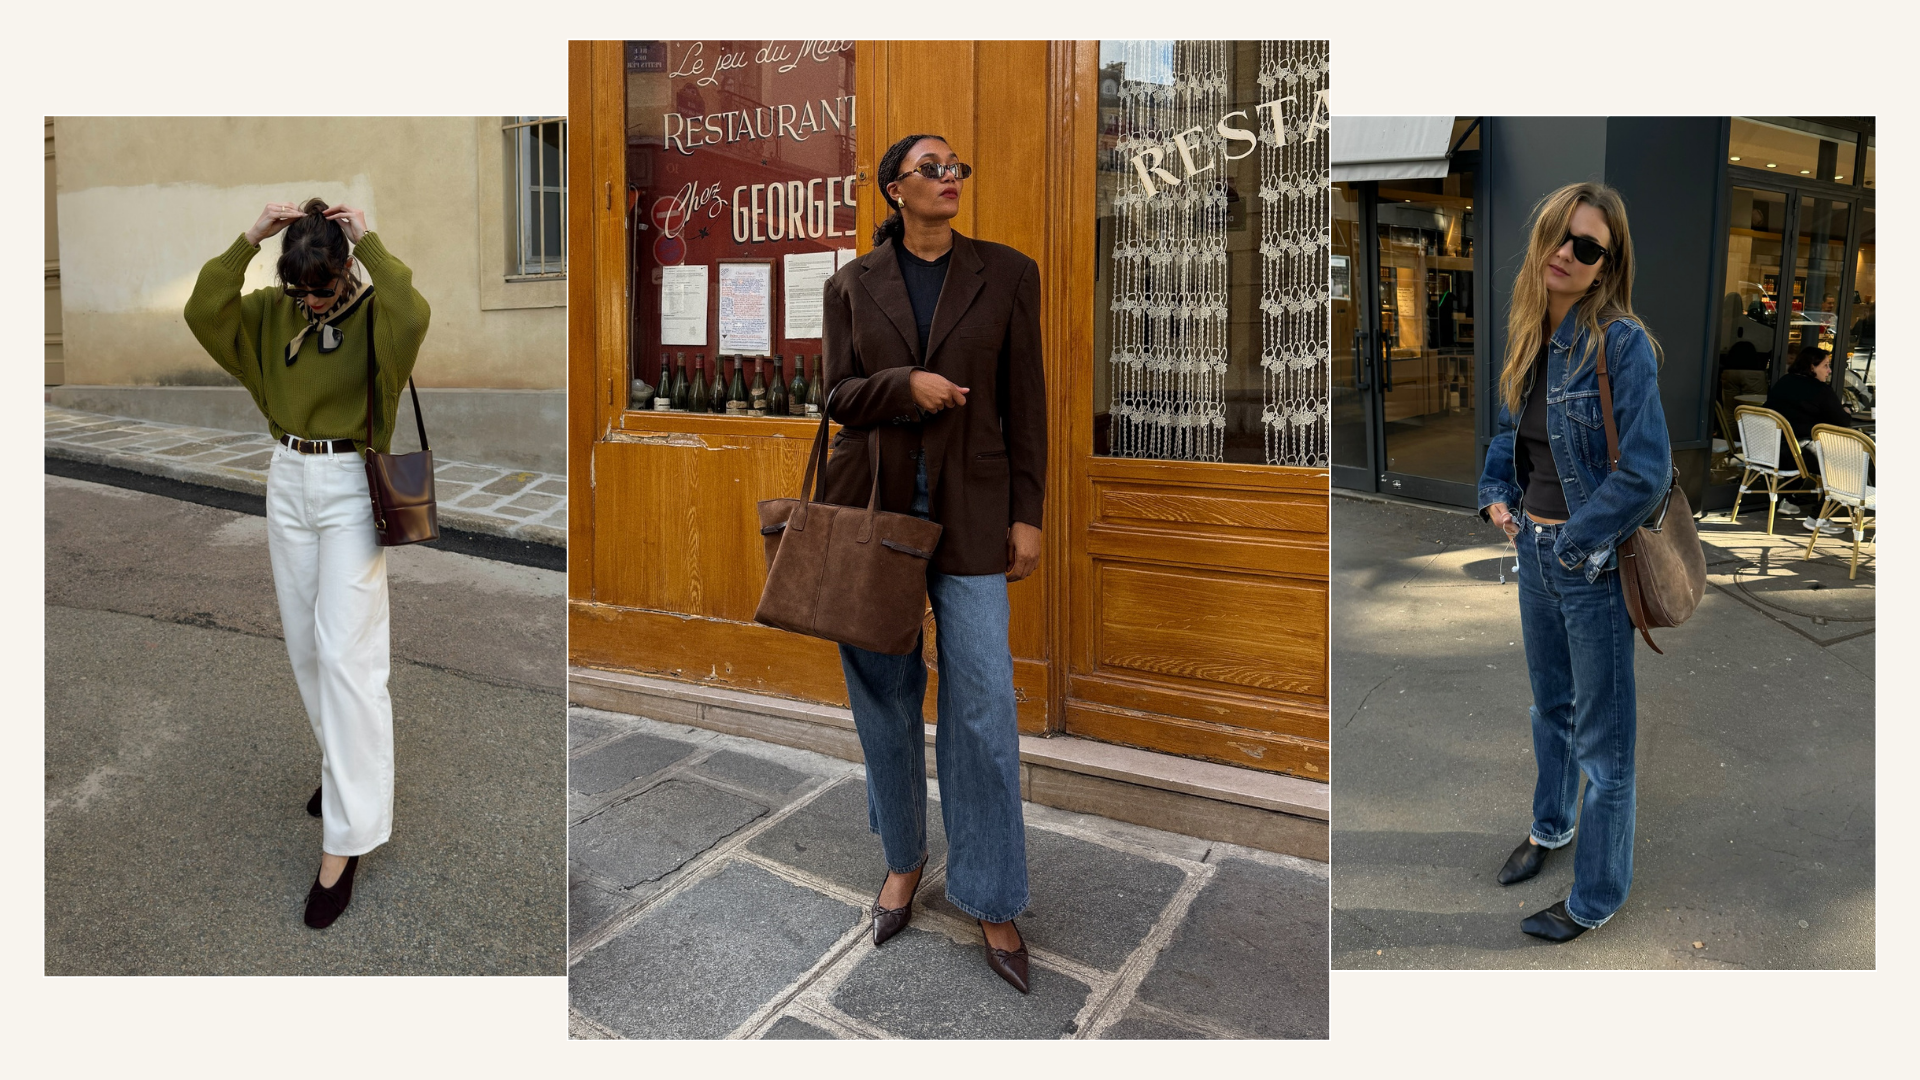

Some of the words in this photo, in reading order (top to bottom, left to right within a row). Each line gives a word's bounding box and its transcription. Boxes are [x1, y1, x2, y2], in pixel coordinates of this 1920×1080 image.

[669, 41, 704, 78] Le
[697, 47, 748, 86] jeu
[755, 40, 790, 64] du
[663, 95, 856, 155] RESTAURANT
[664, 180, 728, 239] Chez
[732, 175, 856, 243] GEORGES
